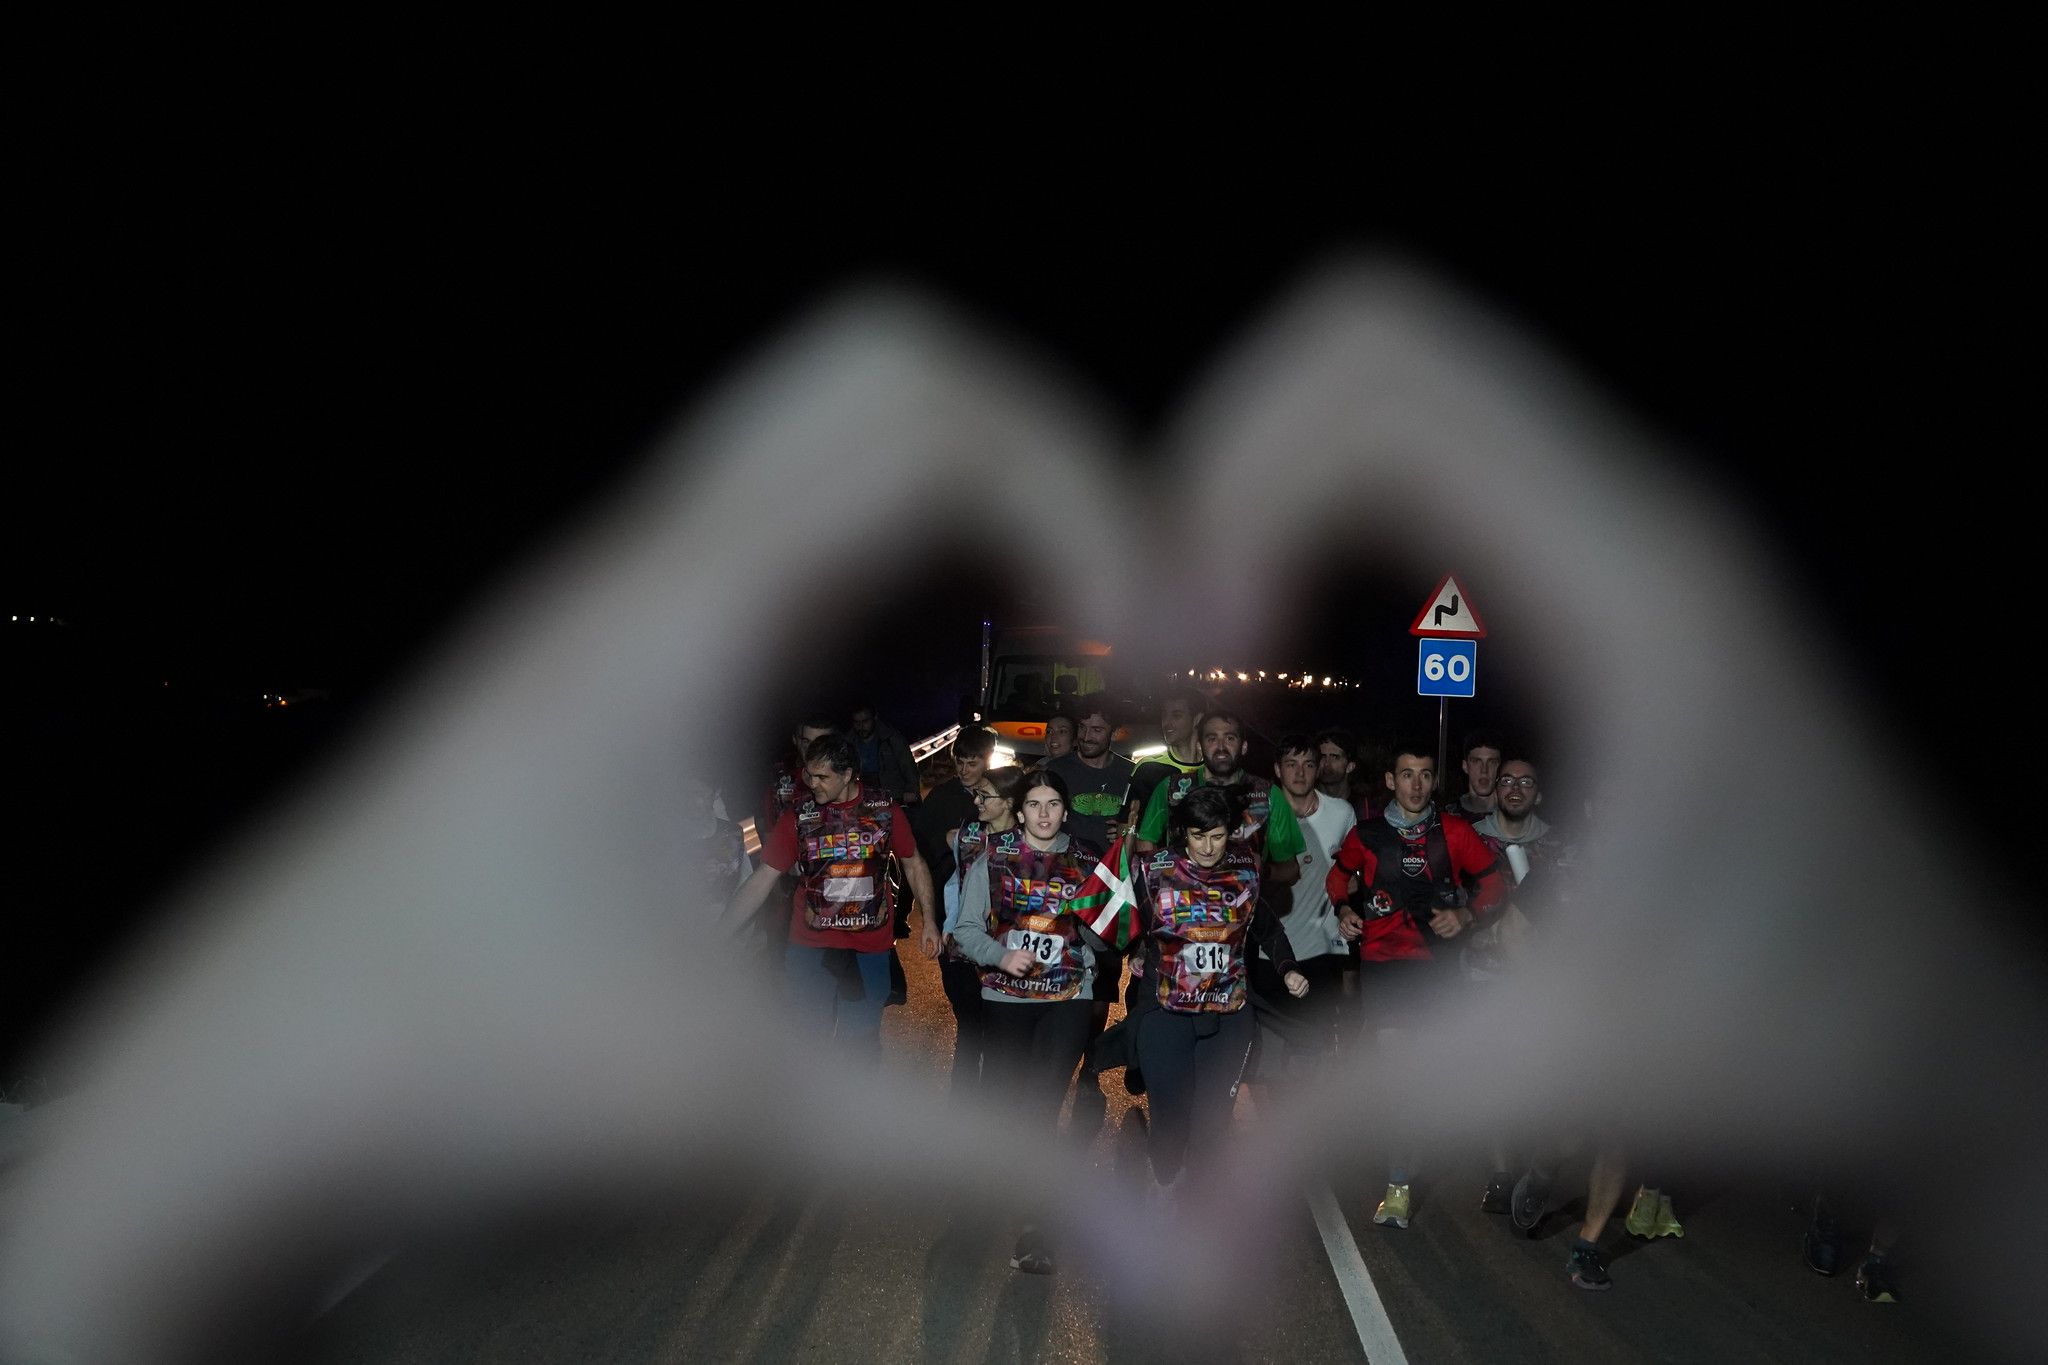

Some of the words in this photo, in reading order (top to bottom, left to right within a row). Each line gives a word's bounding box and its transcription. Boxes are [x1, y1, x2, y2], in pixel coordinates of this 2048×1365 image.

[1424, 653, 1471, 682] 60
[1021, 933, 1053, 960] 813
[1196, 946, 1224, 970] 813
